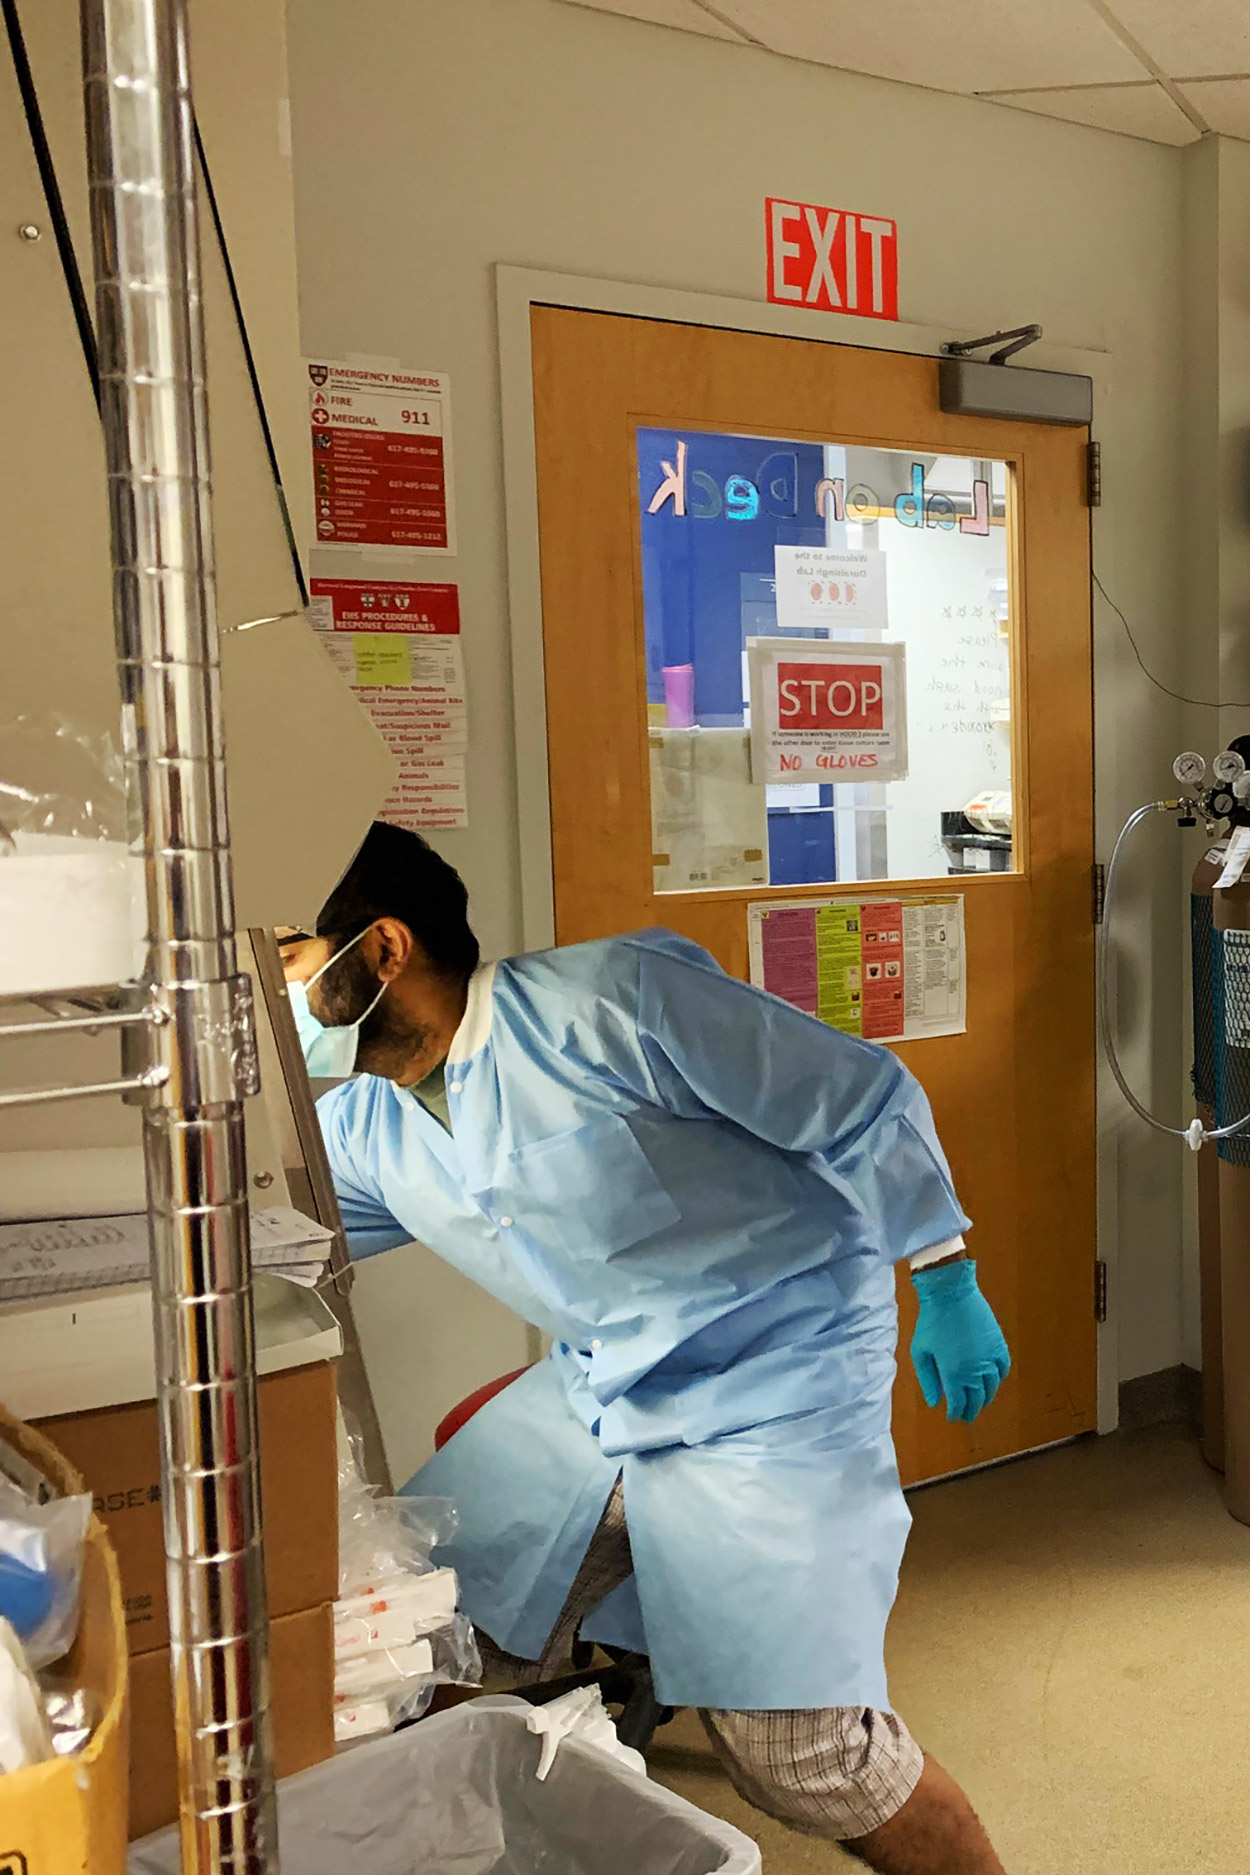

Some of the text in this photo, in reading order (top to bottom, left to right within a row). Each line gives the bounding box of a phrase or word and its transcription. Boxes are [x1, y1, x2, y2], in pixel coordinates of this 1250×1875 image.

[771, 201, 892, 313] EXIT
[329, 368, 389, 382] EMERGENCY
[392, 374, 440, 388] NUMBERS
[331, 396, 353, 406] FIRE
[332, 414, 379, 426] MEDICAL
[401, 410, 430, 425] 911
[362, 612, 420, 622] PROCEDURES
[335, 620, 436, 632] RESPONSE GUIDELINES
[780, 679, 881, 717] STOP
[780, 753, 879, 771] NO GLOVES
